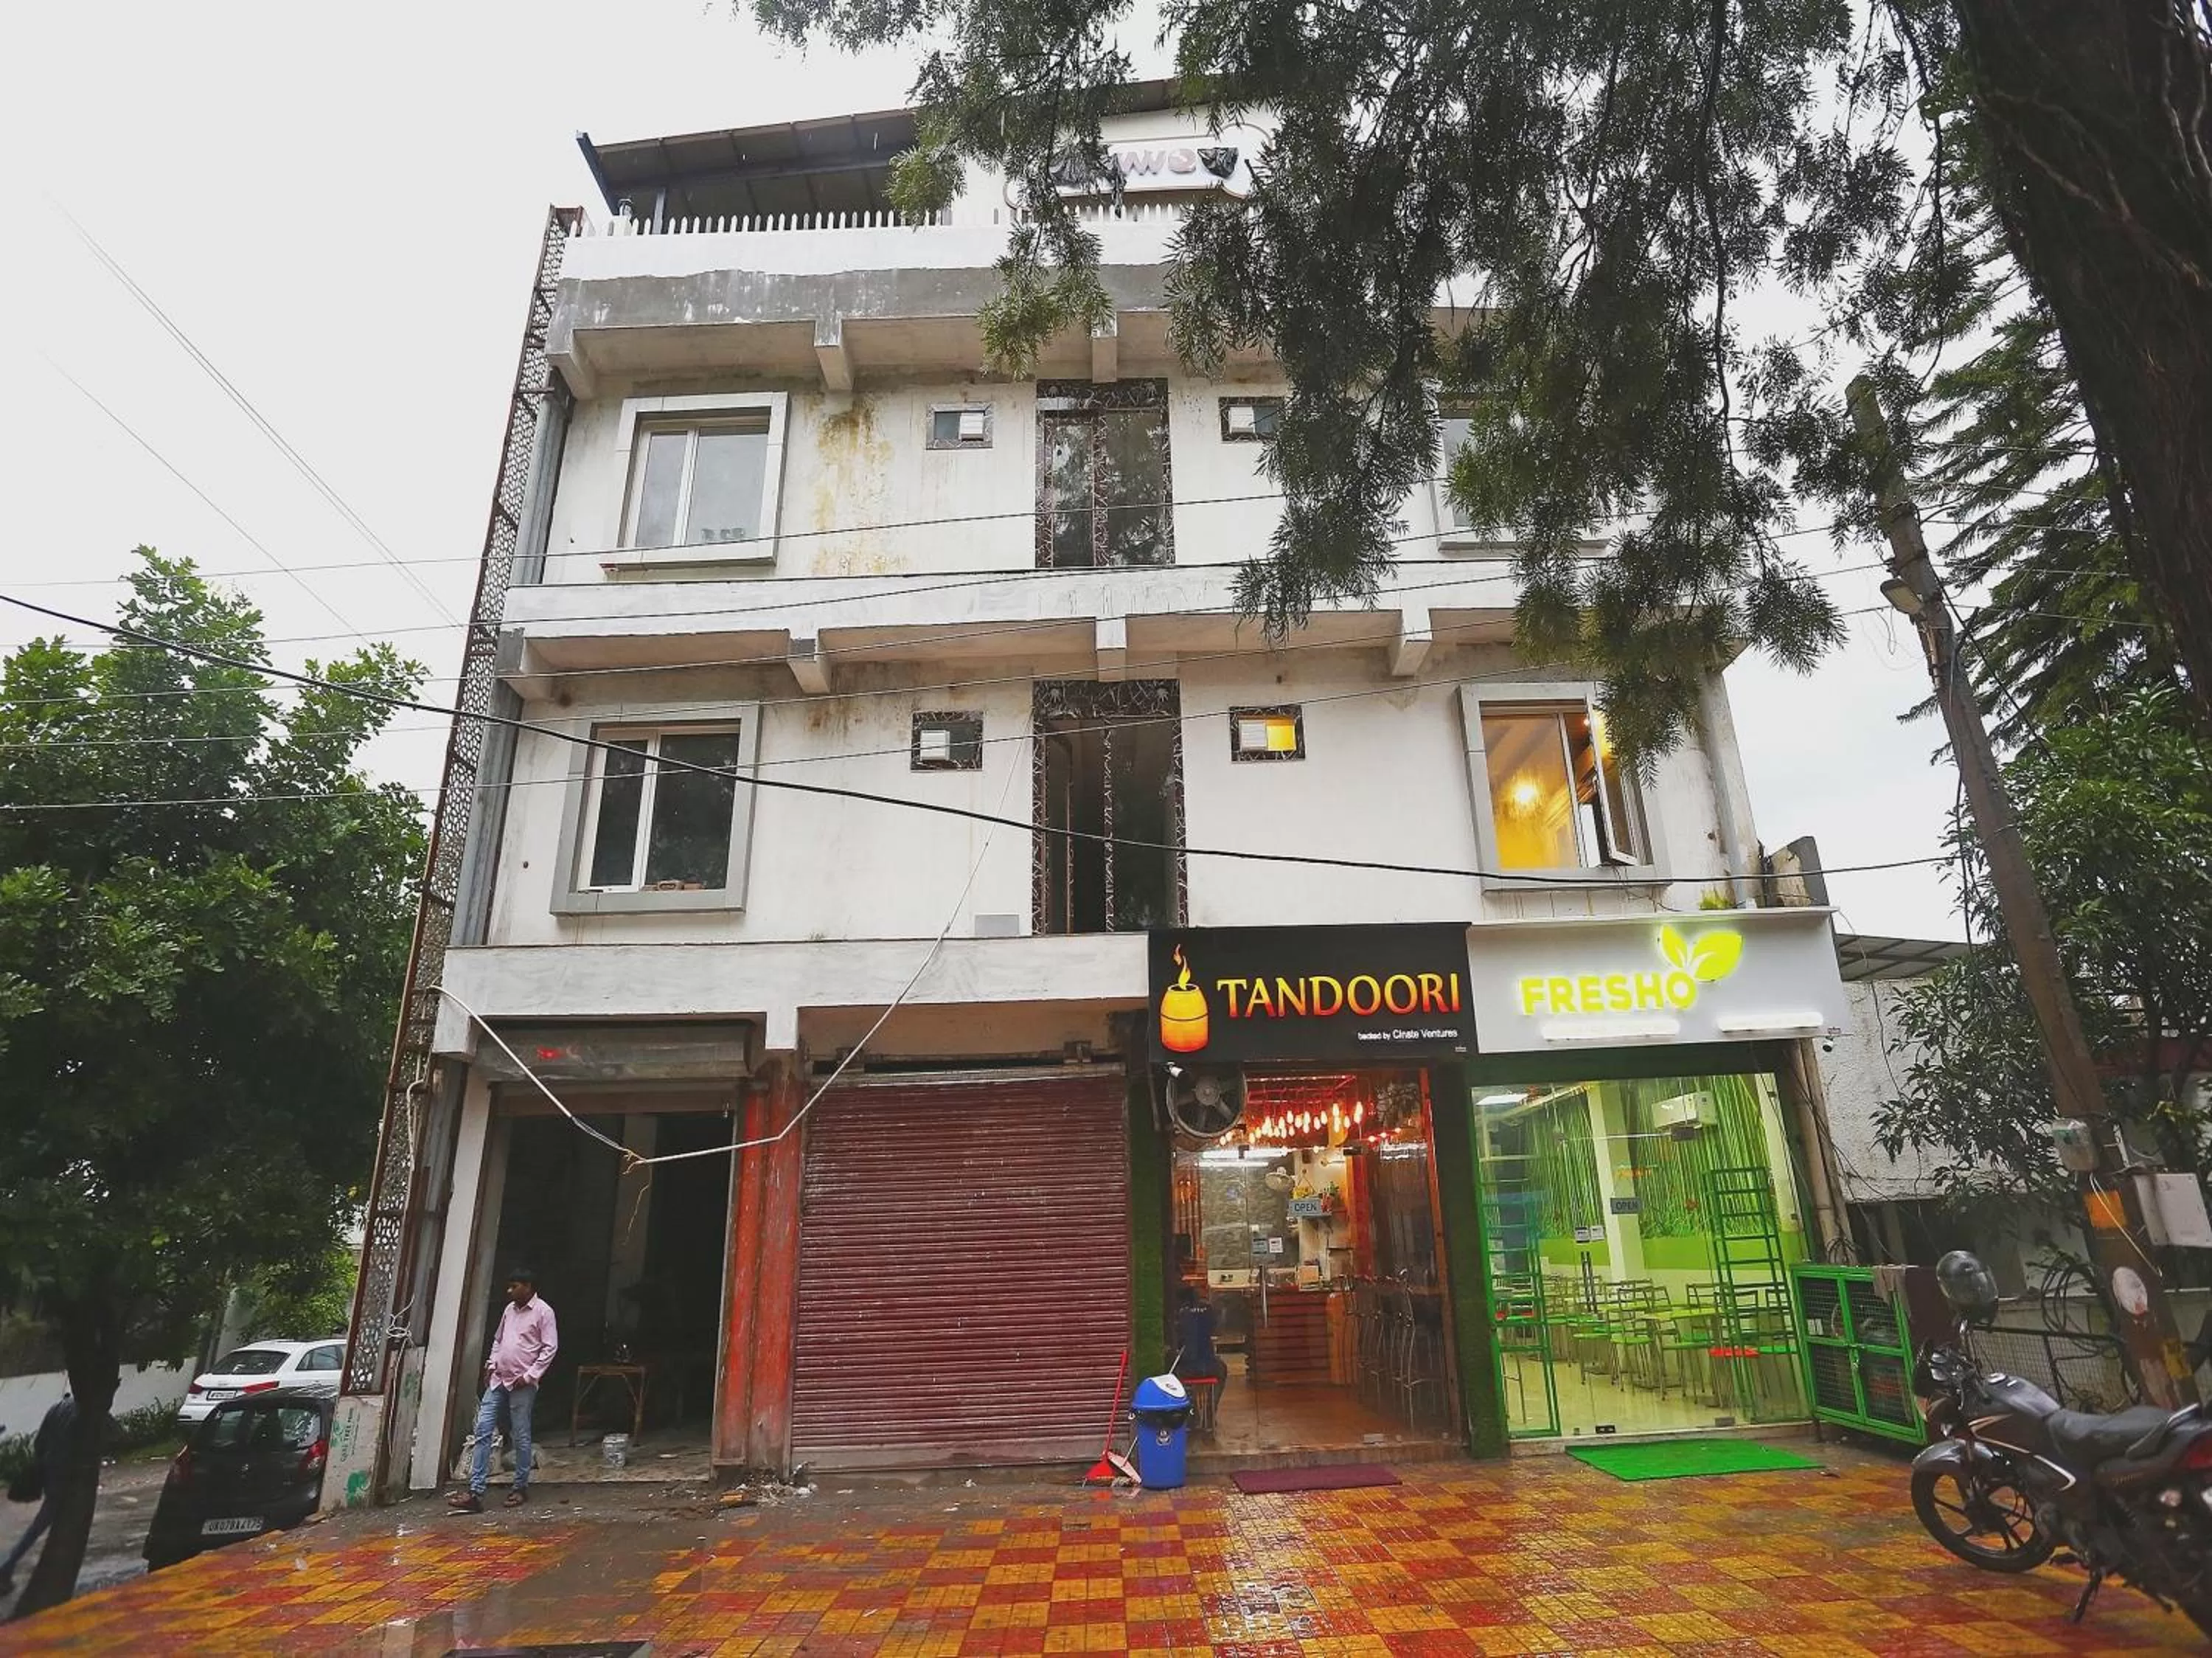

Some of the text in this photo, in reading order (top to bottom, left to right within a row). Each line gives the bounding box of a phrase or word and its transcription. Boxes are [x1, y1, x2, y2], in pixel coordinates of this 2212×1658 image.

[1217, 972, 1461, 1018] TANDOORI
[1520, 970, 1698, 1016] FRESHO
[1382, 1032, 1391, 1041] by
[1420, 1028, 1458, 1038] Ventures
[1294, 1202, 1318, 1212] OPEN
[1615, 1201, 1638, 1210] OPEN
